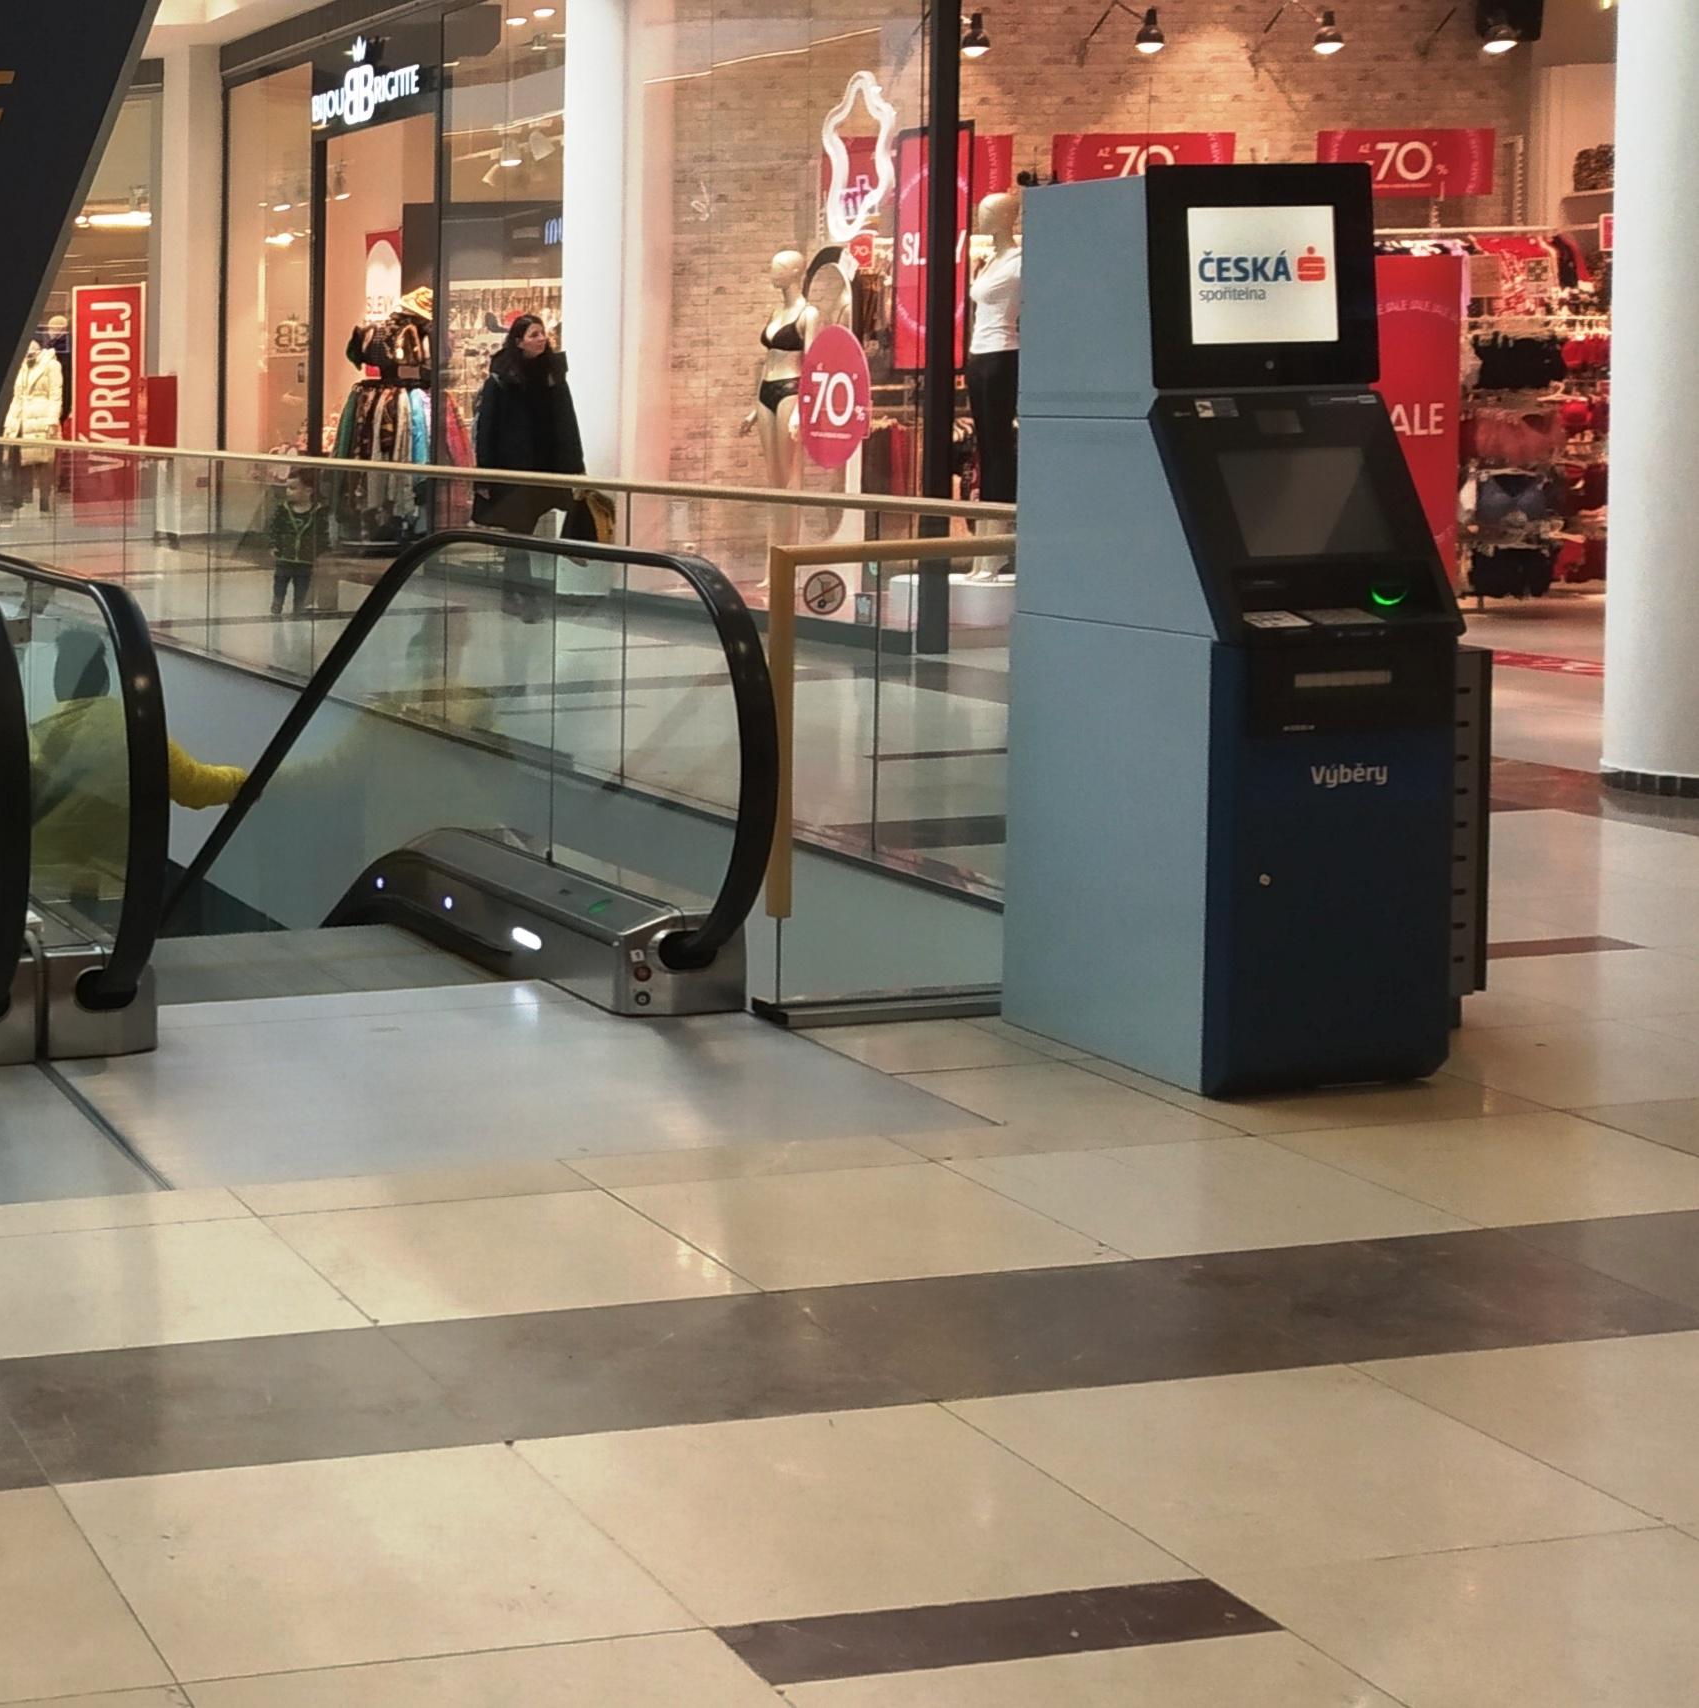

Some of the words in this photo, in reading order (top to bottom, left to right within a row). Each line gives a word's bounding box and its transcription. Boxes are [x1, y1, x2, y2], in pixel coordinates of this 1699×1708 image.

[311, 87, 345, 126] BIJOU
[1198, 249, 1293, 283] ČESKÁ
[1199, 287, 1267, 303] spořitelna
[78, 301, 132, 474] VÝPRODEJ
[1390, 402, 1446, 437] ALE
[1310, 762, 1389, 788] Výběry
